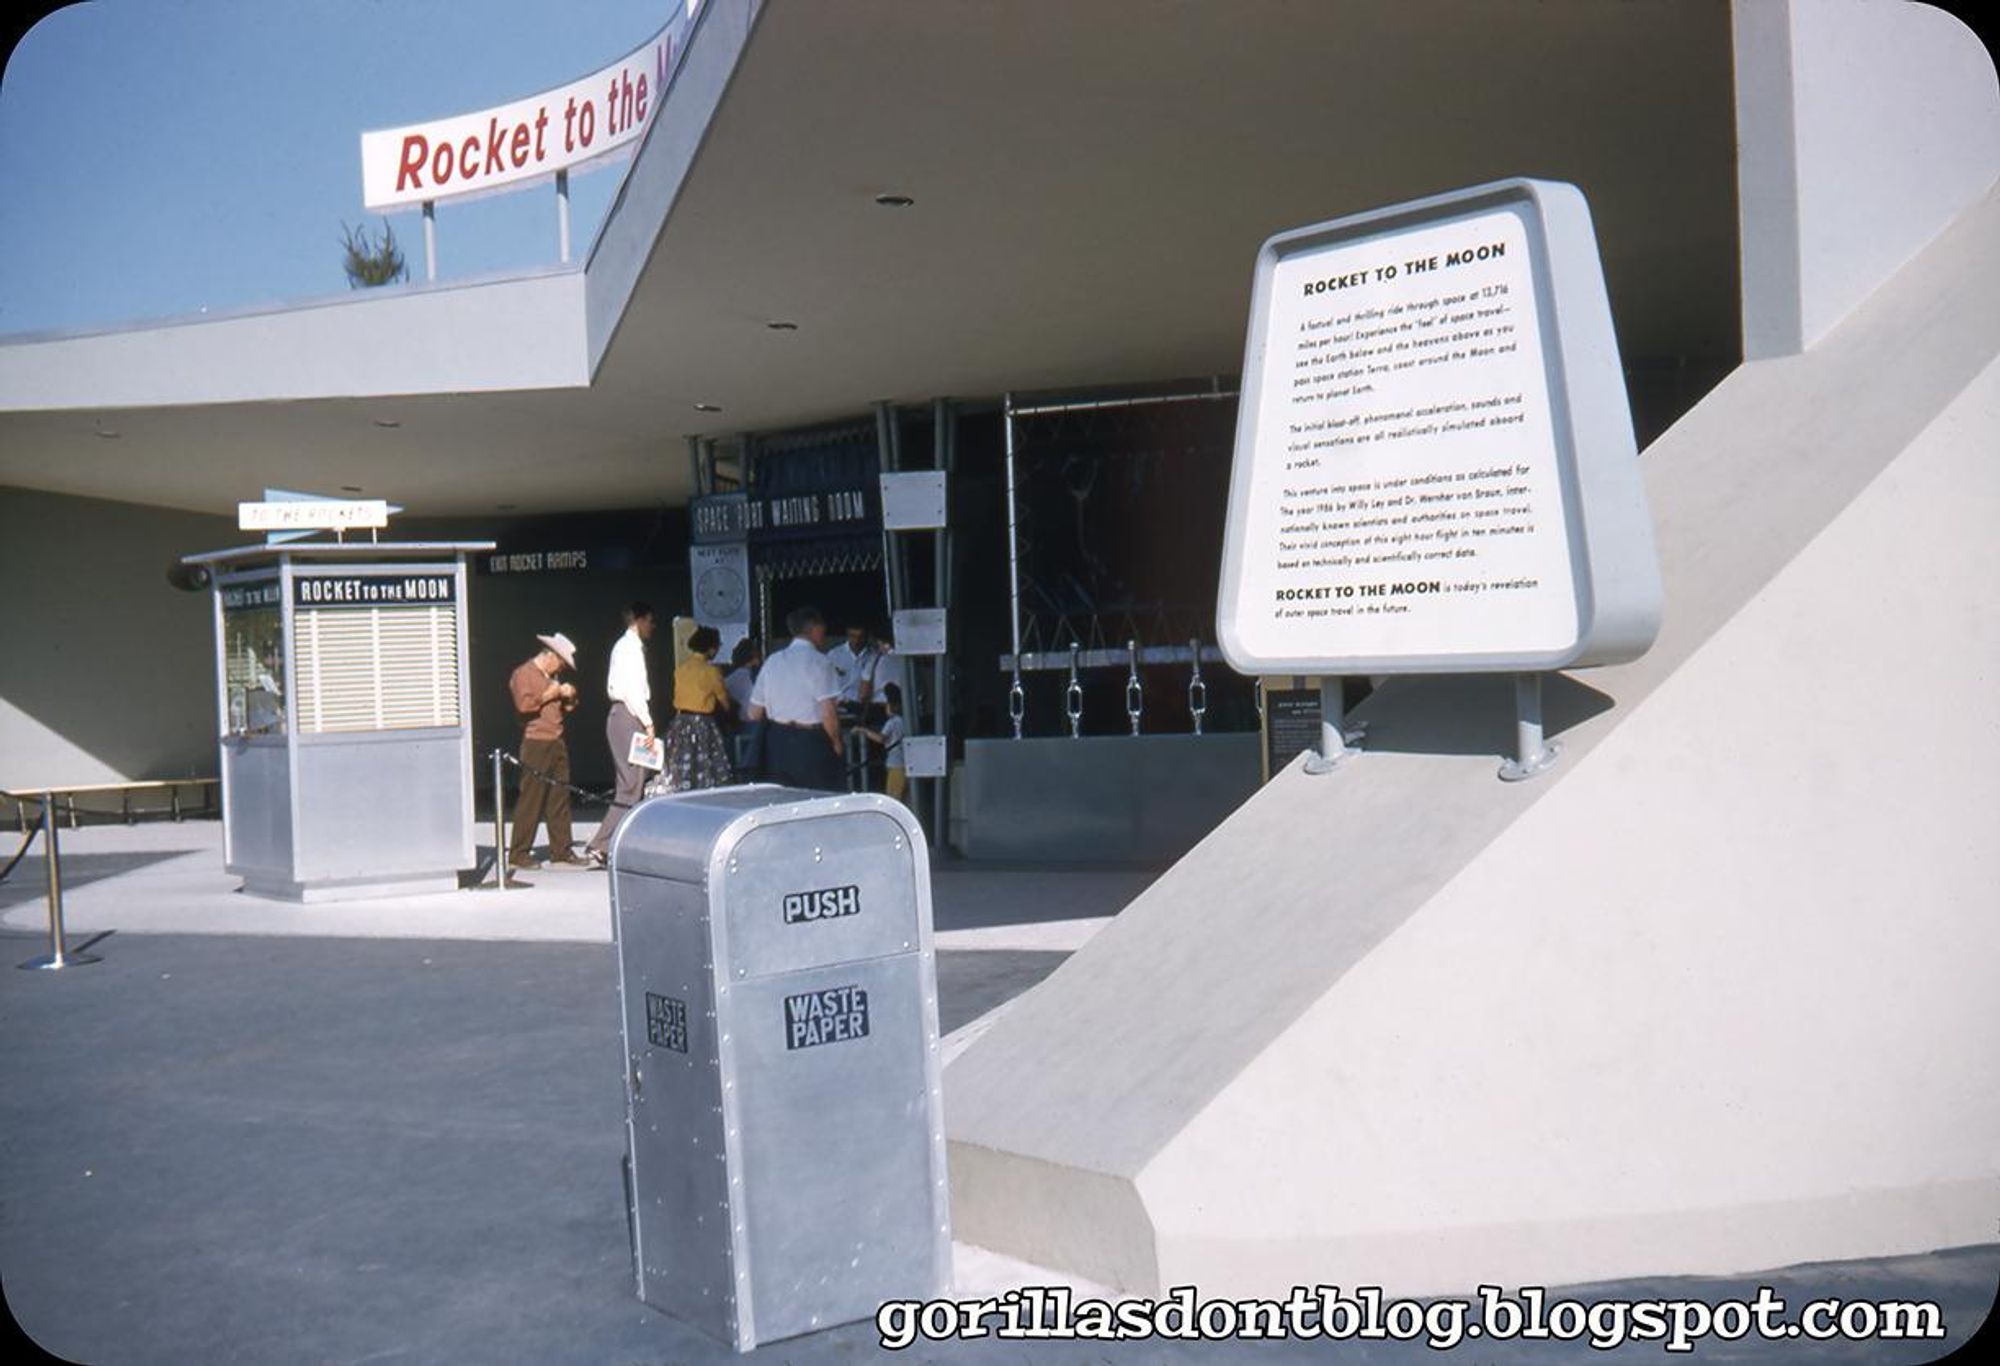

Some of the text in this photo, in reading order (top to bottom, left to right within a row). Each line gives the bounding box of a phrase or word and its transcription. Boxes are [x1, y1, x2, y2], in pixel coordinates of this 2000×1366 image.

[396, 68, 648, 191] Rocket to the
[1304, 243, 1505, 296] ROCKET TO THE MOON
[697, 491, 864, 534] SPACE PORT WAITING ROOM
[547, 550, 587, 569] RAMPS
[301, 578, 448, 601] ROCKET TO THE MOON
[1276, 587, 1331, 600] ROCKET
[1335, 586, 1354, 597] TO
[1359, 584, 1386, 596] THE
[1391, 581, 1440, 595] MOON
[1491, 577, 1538, 589] revelation
[786, 887, 858, 922] PUSH
[648, 994, 685, 1027] WASTE
[789, 985, 865, 1022] WASTE
[650, 1019, 685, 1052] PAPER
[792, 1015, 864, 1048] PAPER
